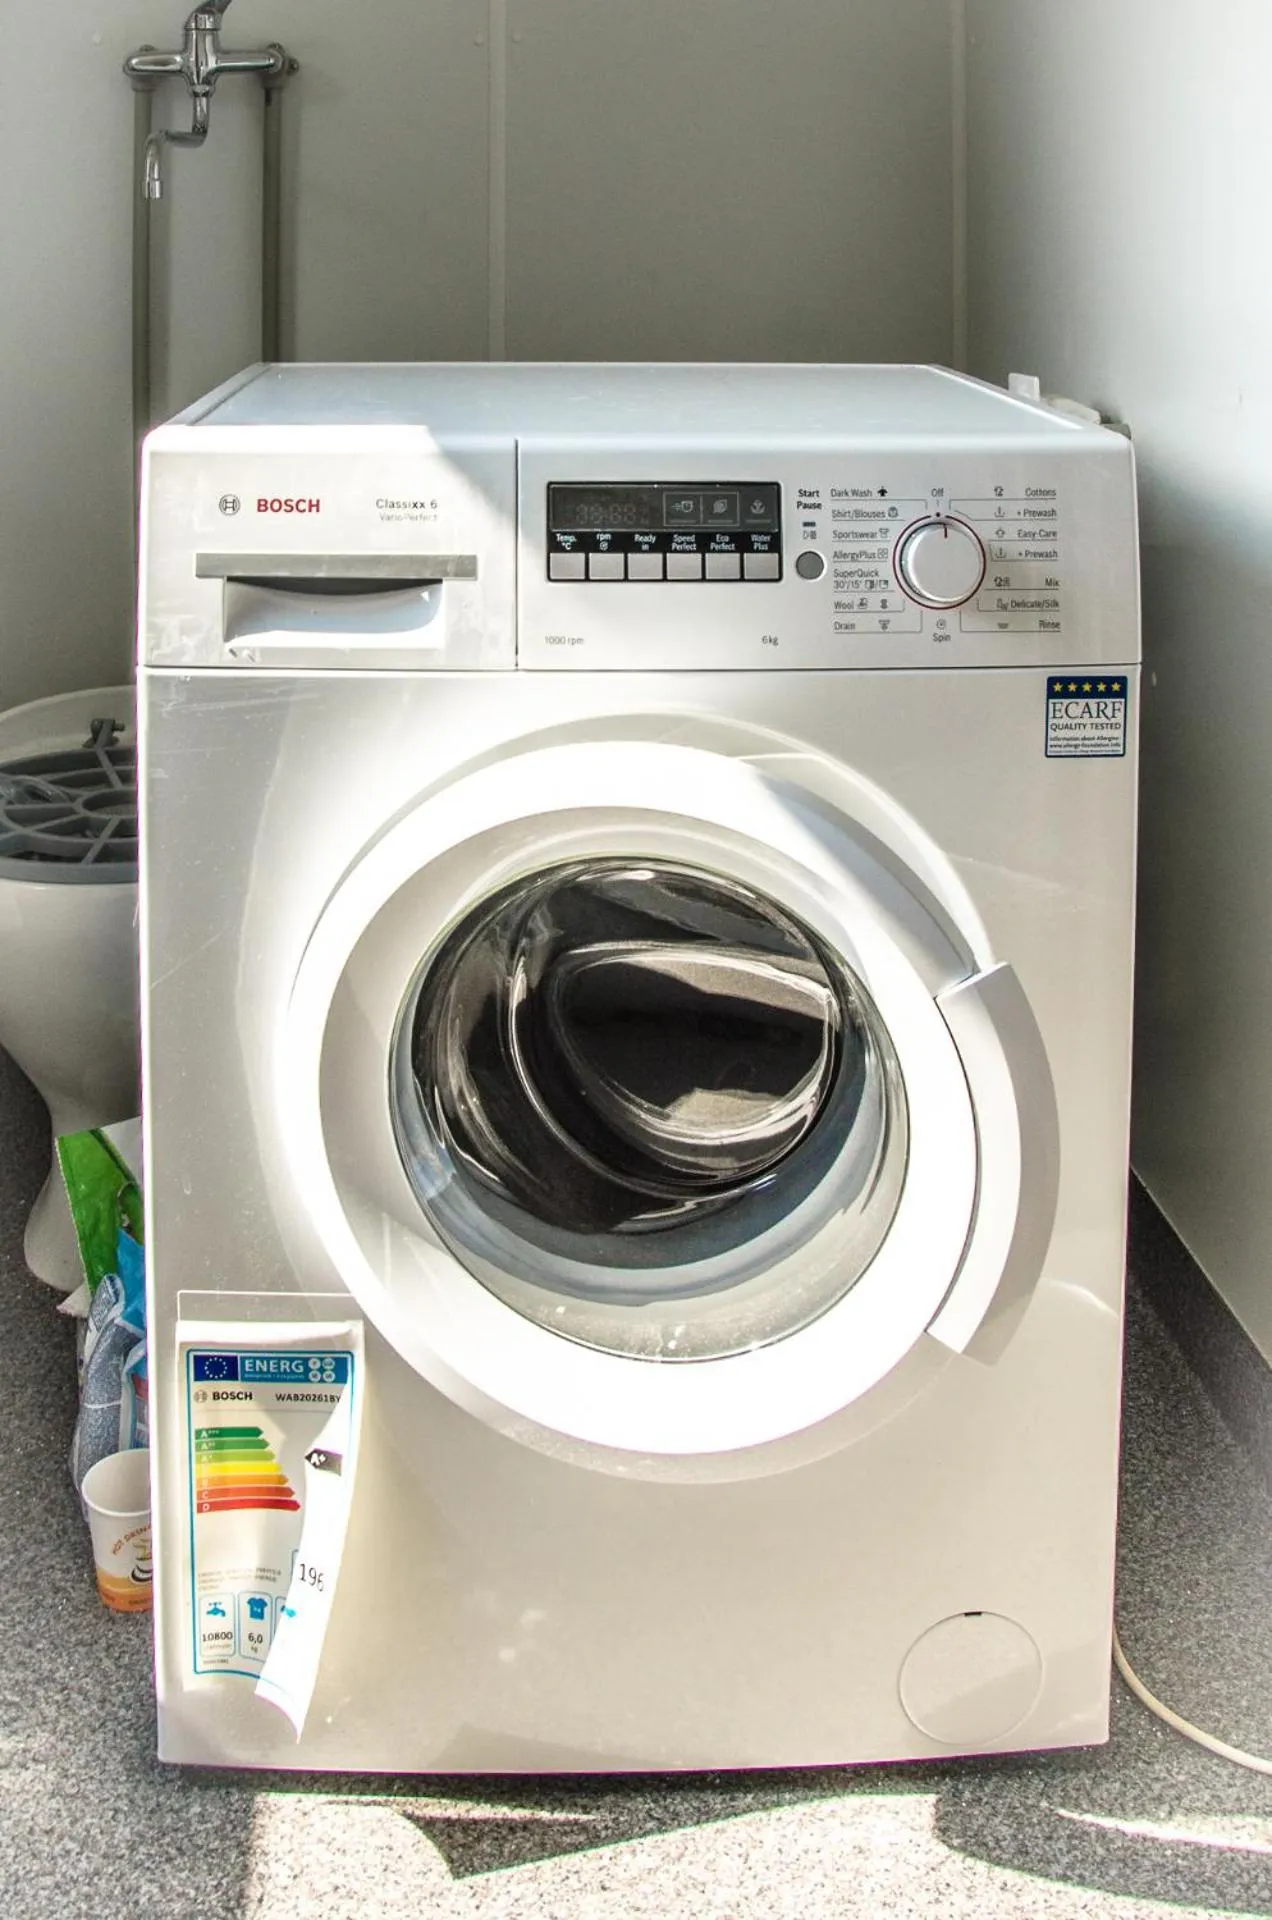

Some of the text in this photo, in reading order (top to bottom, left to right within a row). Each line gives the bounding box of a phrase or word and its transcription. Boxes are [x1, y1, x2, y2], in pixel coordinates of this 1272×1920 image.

[798, 489, 820, 497] Start
[830, 488, 873, 497] Dark Wash
[931, 488, 944, 497] Off
[1025, 487, 1057, 497] Cottons
[256, 498, 321, 513] BOSCH
[375, 498, 438, 509] Classixx 6
[797, 501, 822, 510] Pause
[831, 508, 886, 519] Shirt/Blouses
[1023, 508, 1057, 517] Prewash
[556, 533, 577, 543] Temp.
[596, 533, 612, 542] rpm
[634, 534, 657, 543] Ready
[673, 534, 696, 543] Speed
[715, 534, 730, 543] Eco
[750, 534, 771, 542] Water
[832, 530, 878, 540] Sportswear
[1017, 528, 1058, 539] Easy Care
[641, 543, 650, 551] in
[671, 542, 697, 551] Perfect
[710, 542, 736, 551] Perfect
[753, 542, 769, 551] Plus
[832, 550, 877, 561] AllergyPlus
[1024, 549, 1059, 559] Prewash
[833, 568, 880, 579] SuperQuick
[1045, 577, 1059, 587] Mix
[834, 600, 855, 610] Wool
[1010, 599, 1060, 609] Delicate/Silk
[834, 621, 856, 631] Drain
[1039, 619, 1061, 630] Rinse
[545, 636, 584, 646] 1000 rpm
[932, 633, 951, 643] Spin
[1051, 701, 1123, 720] ECARF
[1050, 722, 1121, 732] QUALITY TESTED
[244, 1359, 305, 1373] ENERG
[212, 1391, 253, 1401] BOSCH
[310, 1452, 327, 1467] A+
[202, 1631, 234, 1642] 10800
[247, 1632, 264, 1645] 6,0
